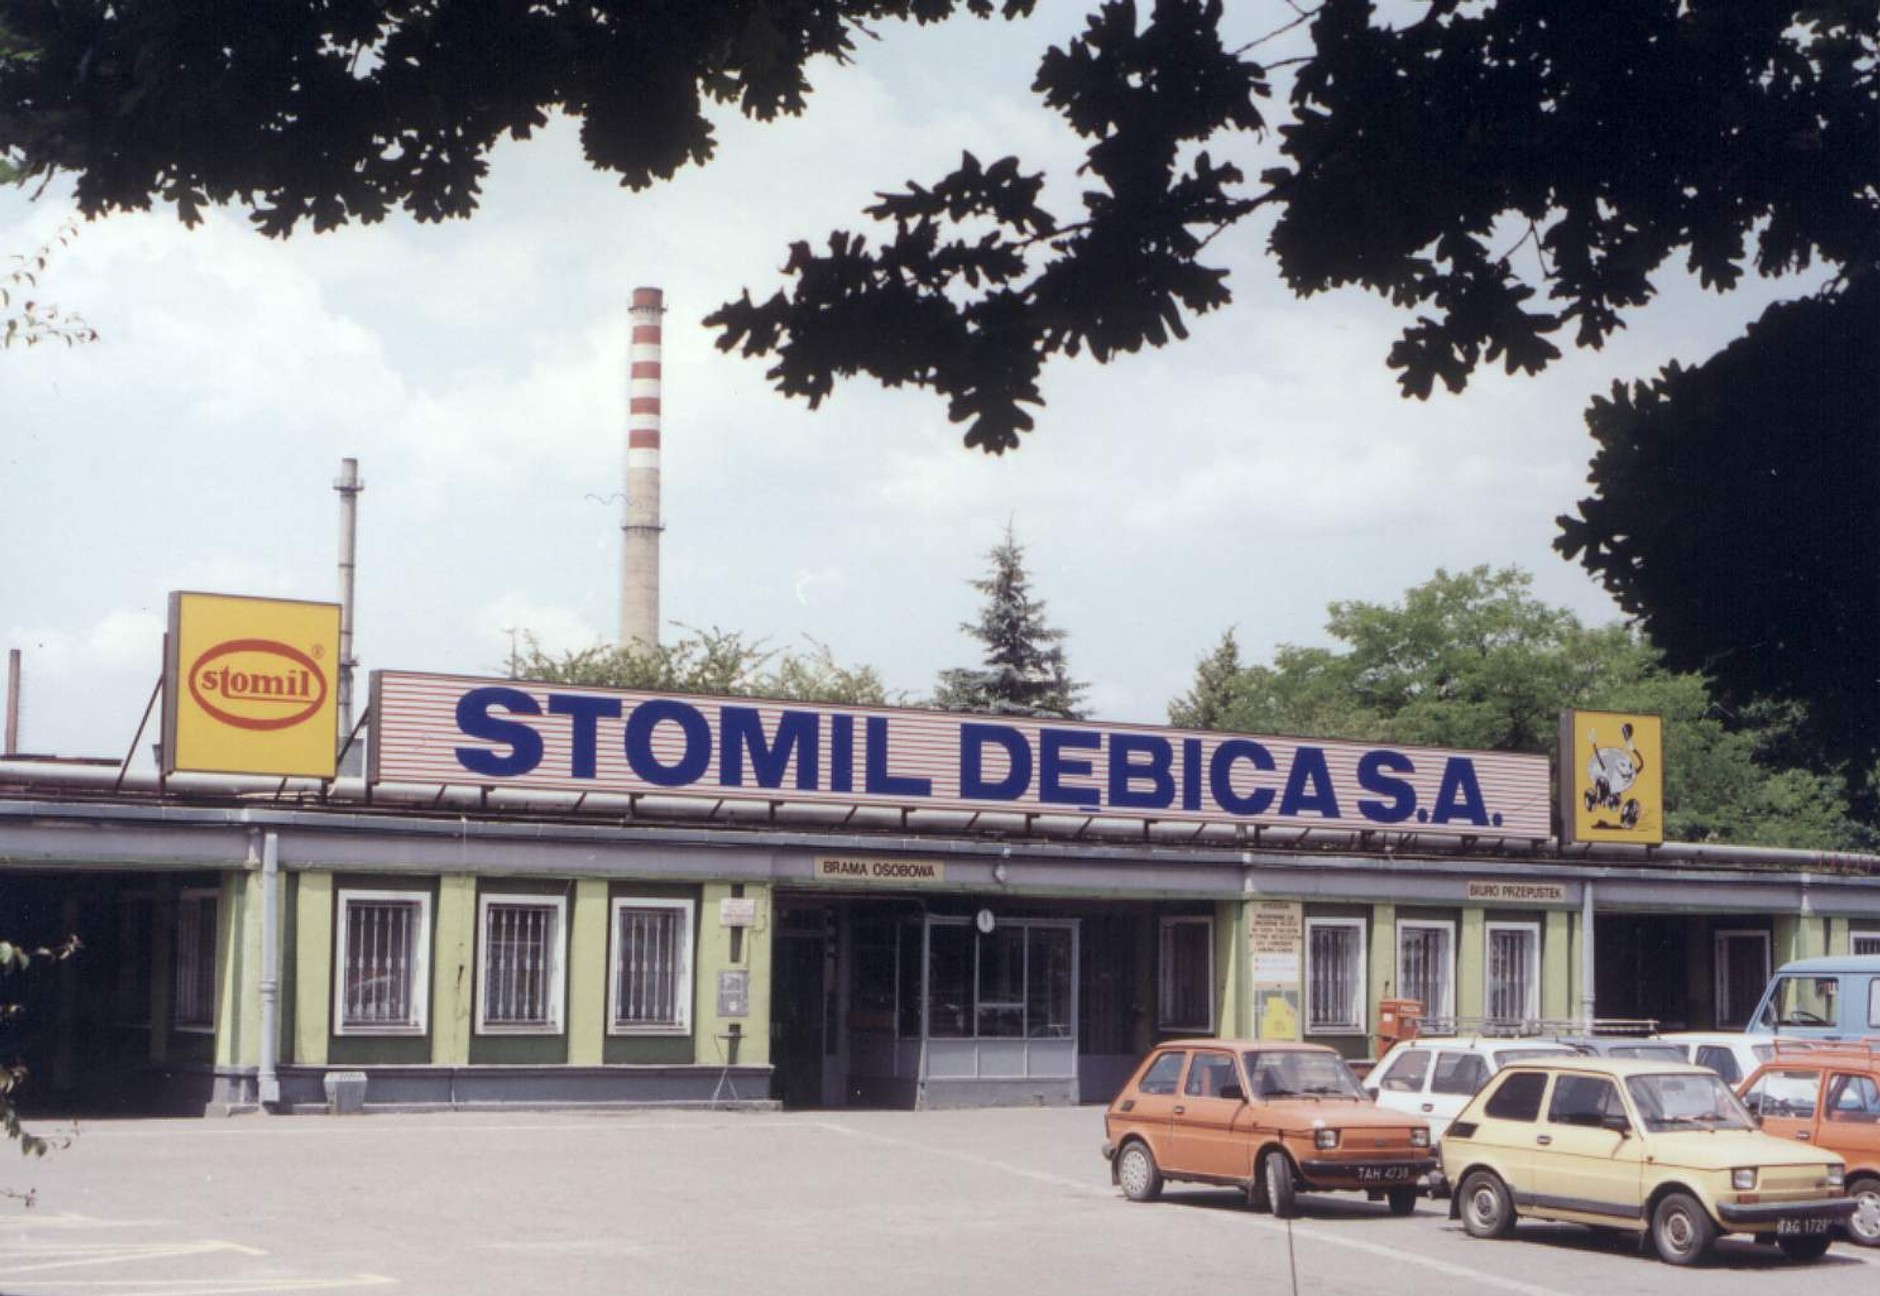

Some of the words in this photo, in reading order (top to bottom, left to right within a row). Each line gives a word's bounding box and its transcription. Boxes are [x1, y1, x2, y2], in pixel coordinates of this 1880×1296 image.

[201, 665, 312, 701] stomil
[456, 687, 930, 795] STOMIL
[1359, 751, 1503, 827] S.A.
[822, 860, 868, 876] BRAMA
[872, 862, 936, 878] OSOBOWA
[1468, 883, 1500, 897] BIURO
[1502, 885, 1562, 899] PRZEPUSTEK
